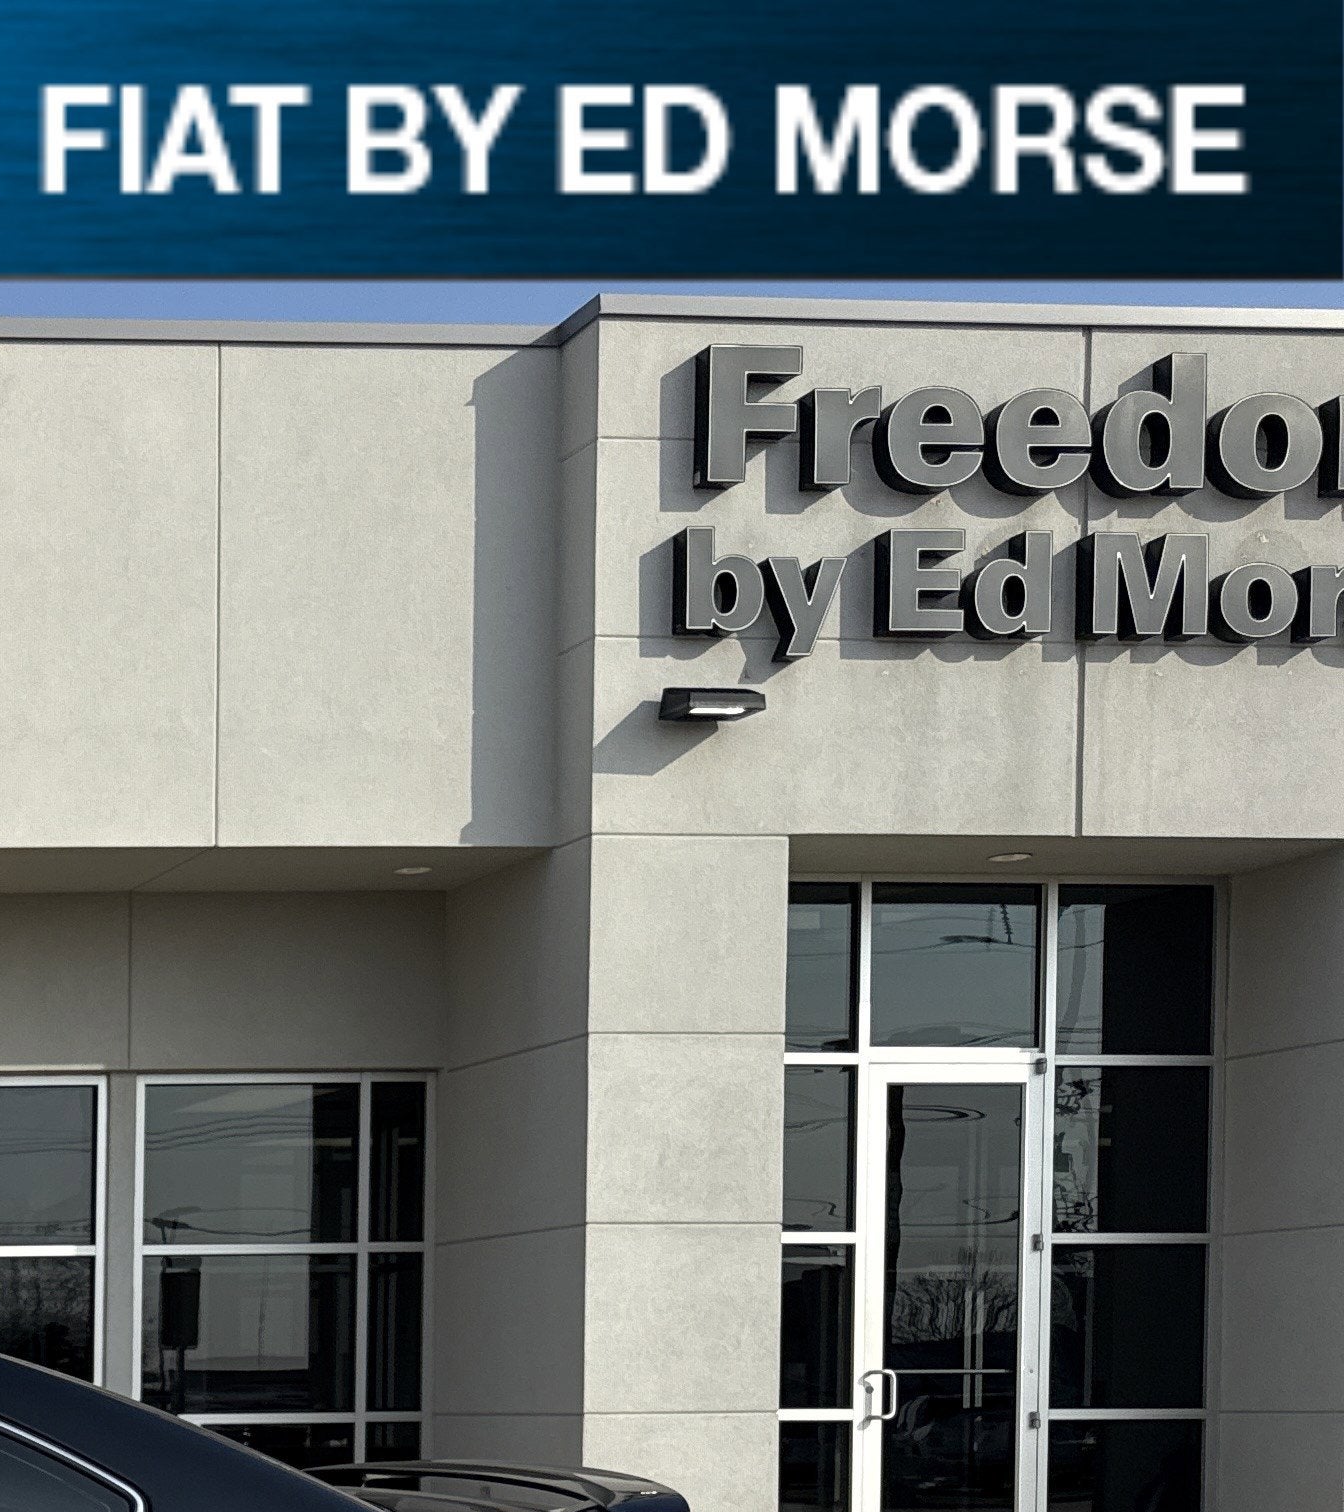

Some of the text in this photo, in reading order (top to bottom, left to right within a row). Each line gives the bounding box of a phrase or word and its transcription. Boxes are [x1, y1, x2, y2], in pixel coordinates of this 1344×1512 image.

[695, 343, 1344, 498] Freedo
[673, 526, 847, 662] by
[874, 528, 1053, 640] Ed
